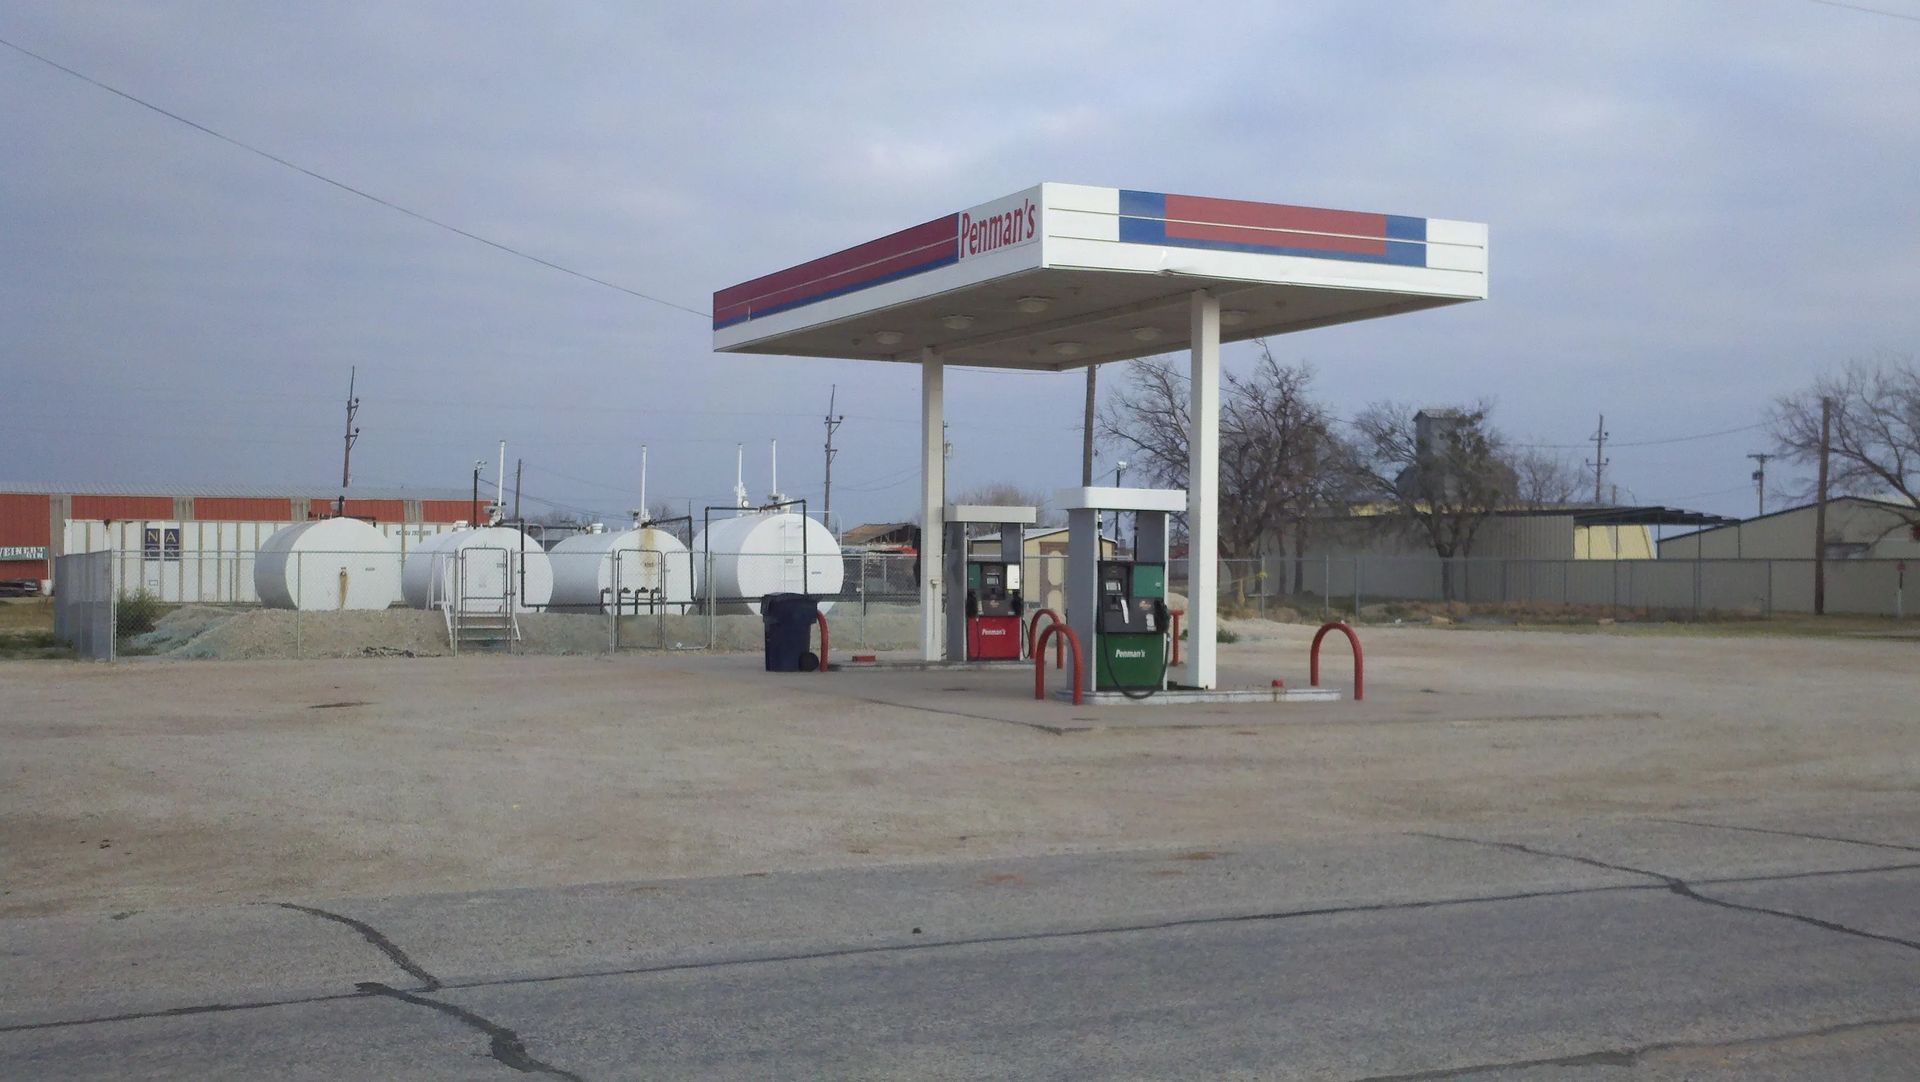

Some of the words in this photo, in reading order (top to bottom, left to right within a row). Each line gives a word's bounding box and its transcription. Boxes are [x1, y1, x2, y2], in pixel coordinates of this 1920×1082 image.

[960, 198, 1035, 258] Penman's
[982, 628, 1006, 636] Penman's
[1115, 649, 1146, 658] Penman's
